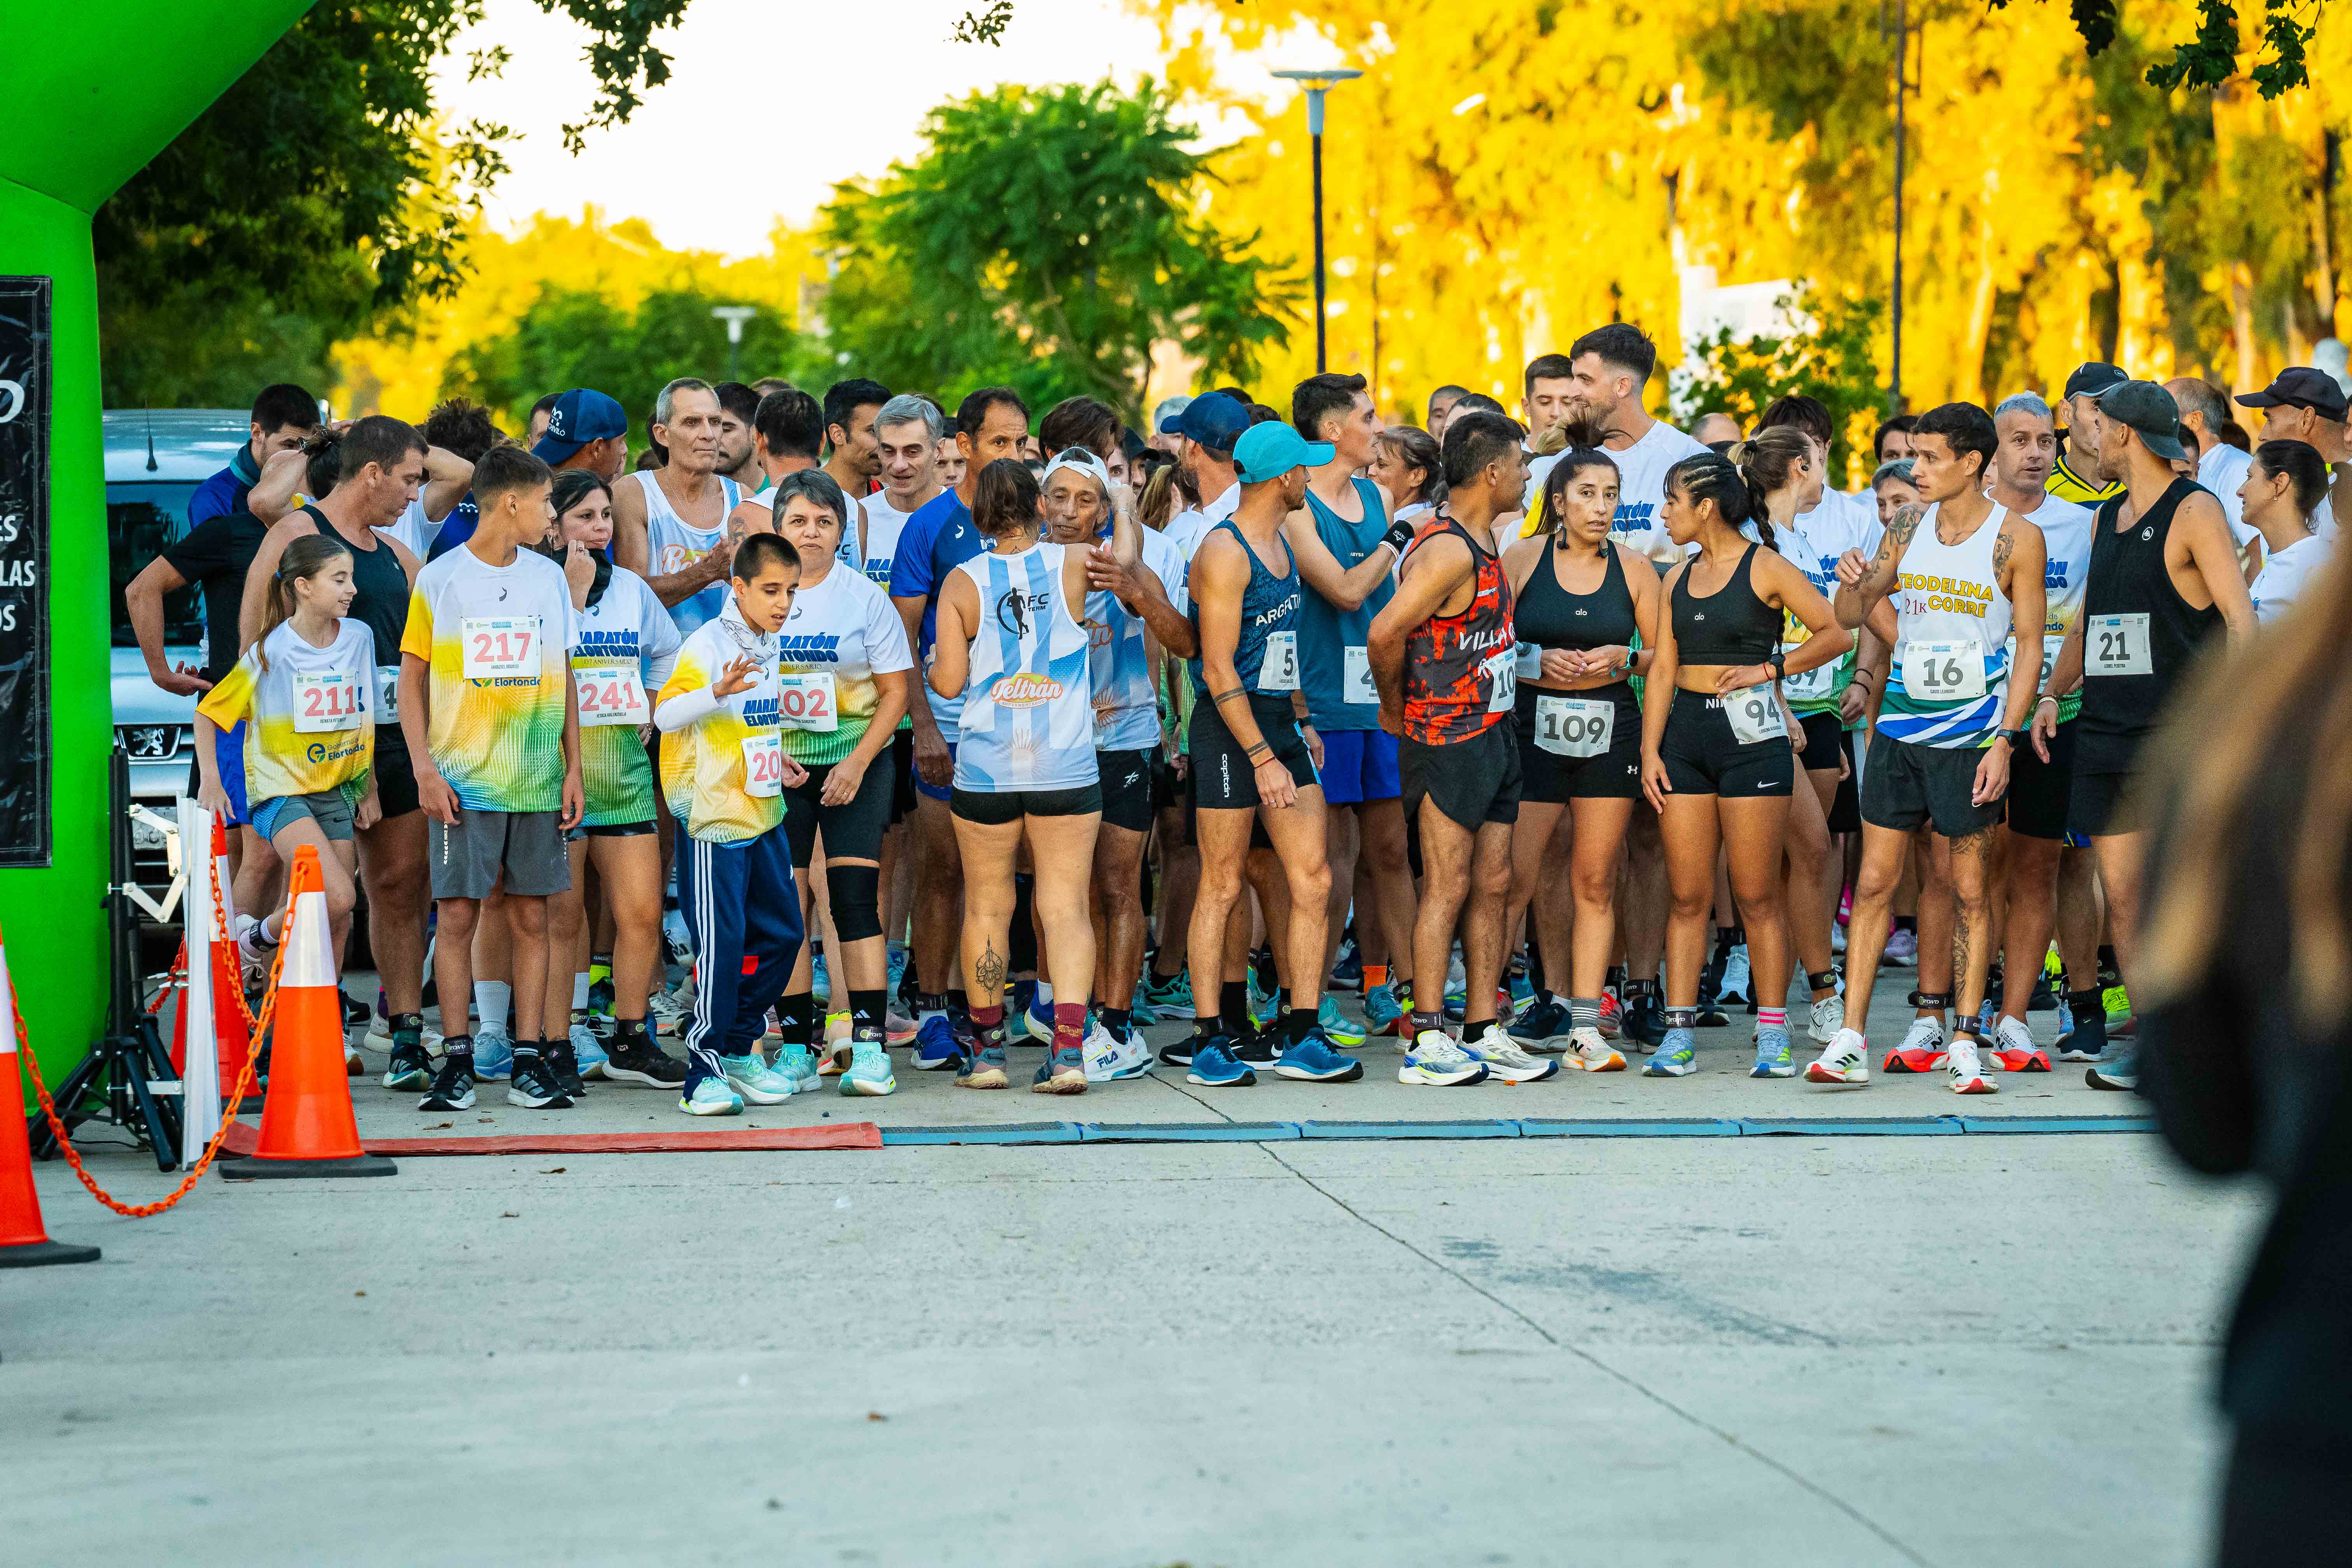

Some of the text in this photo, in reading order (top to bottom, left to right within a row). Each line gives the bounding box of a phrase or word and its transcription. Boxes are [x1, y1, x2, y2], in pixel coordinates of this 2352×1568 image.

[1613, 500, 1655, 519] ATÓN
[1027, 593, 1049, 607] FC
[1899, 573, 1993, 602] TEODELINA
[1694, 612, 1704, 620] alo
[1928, 595, 1987, 618] CORRE
[473, 633, 531, 662] 217
[579, 628, 639, 645] ARATÓN
[780, 632, 840, 649] RATÓN
[2099, 632, 2130, 661] 21
[780, 649, 839, 663] RTONDO
[1283, 648, 1293, 676] 5
[1923, 658, 1963, 686] 16
[304, 685, 355, 716] 211
[383, 682, 397, 710] 4
[579, 682, 641, 711] 241
[743, 698, 778, 714] MARAT
[1706, 698, 1724, 709] NI
[744, 713, 780, 727] ELORTO
[1745, 696, 1780, 727] 94
[1544, 713, 1605, 744] 109
[1221, 754, 1230, 798] capitán
[1096, 1050, 1118, 1068] FILA
